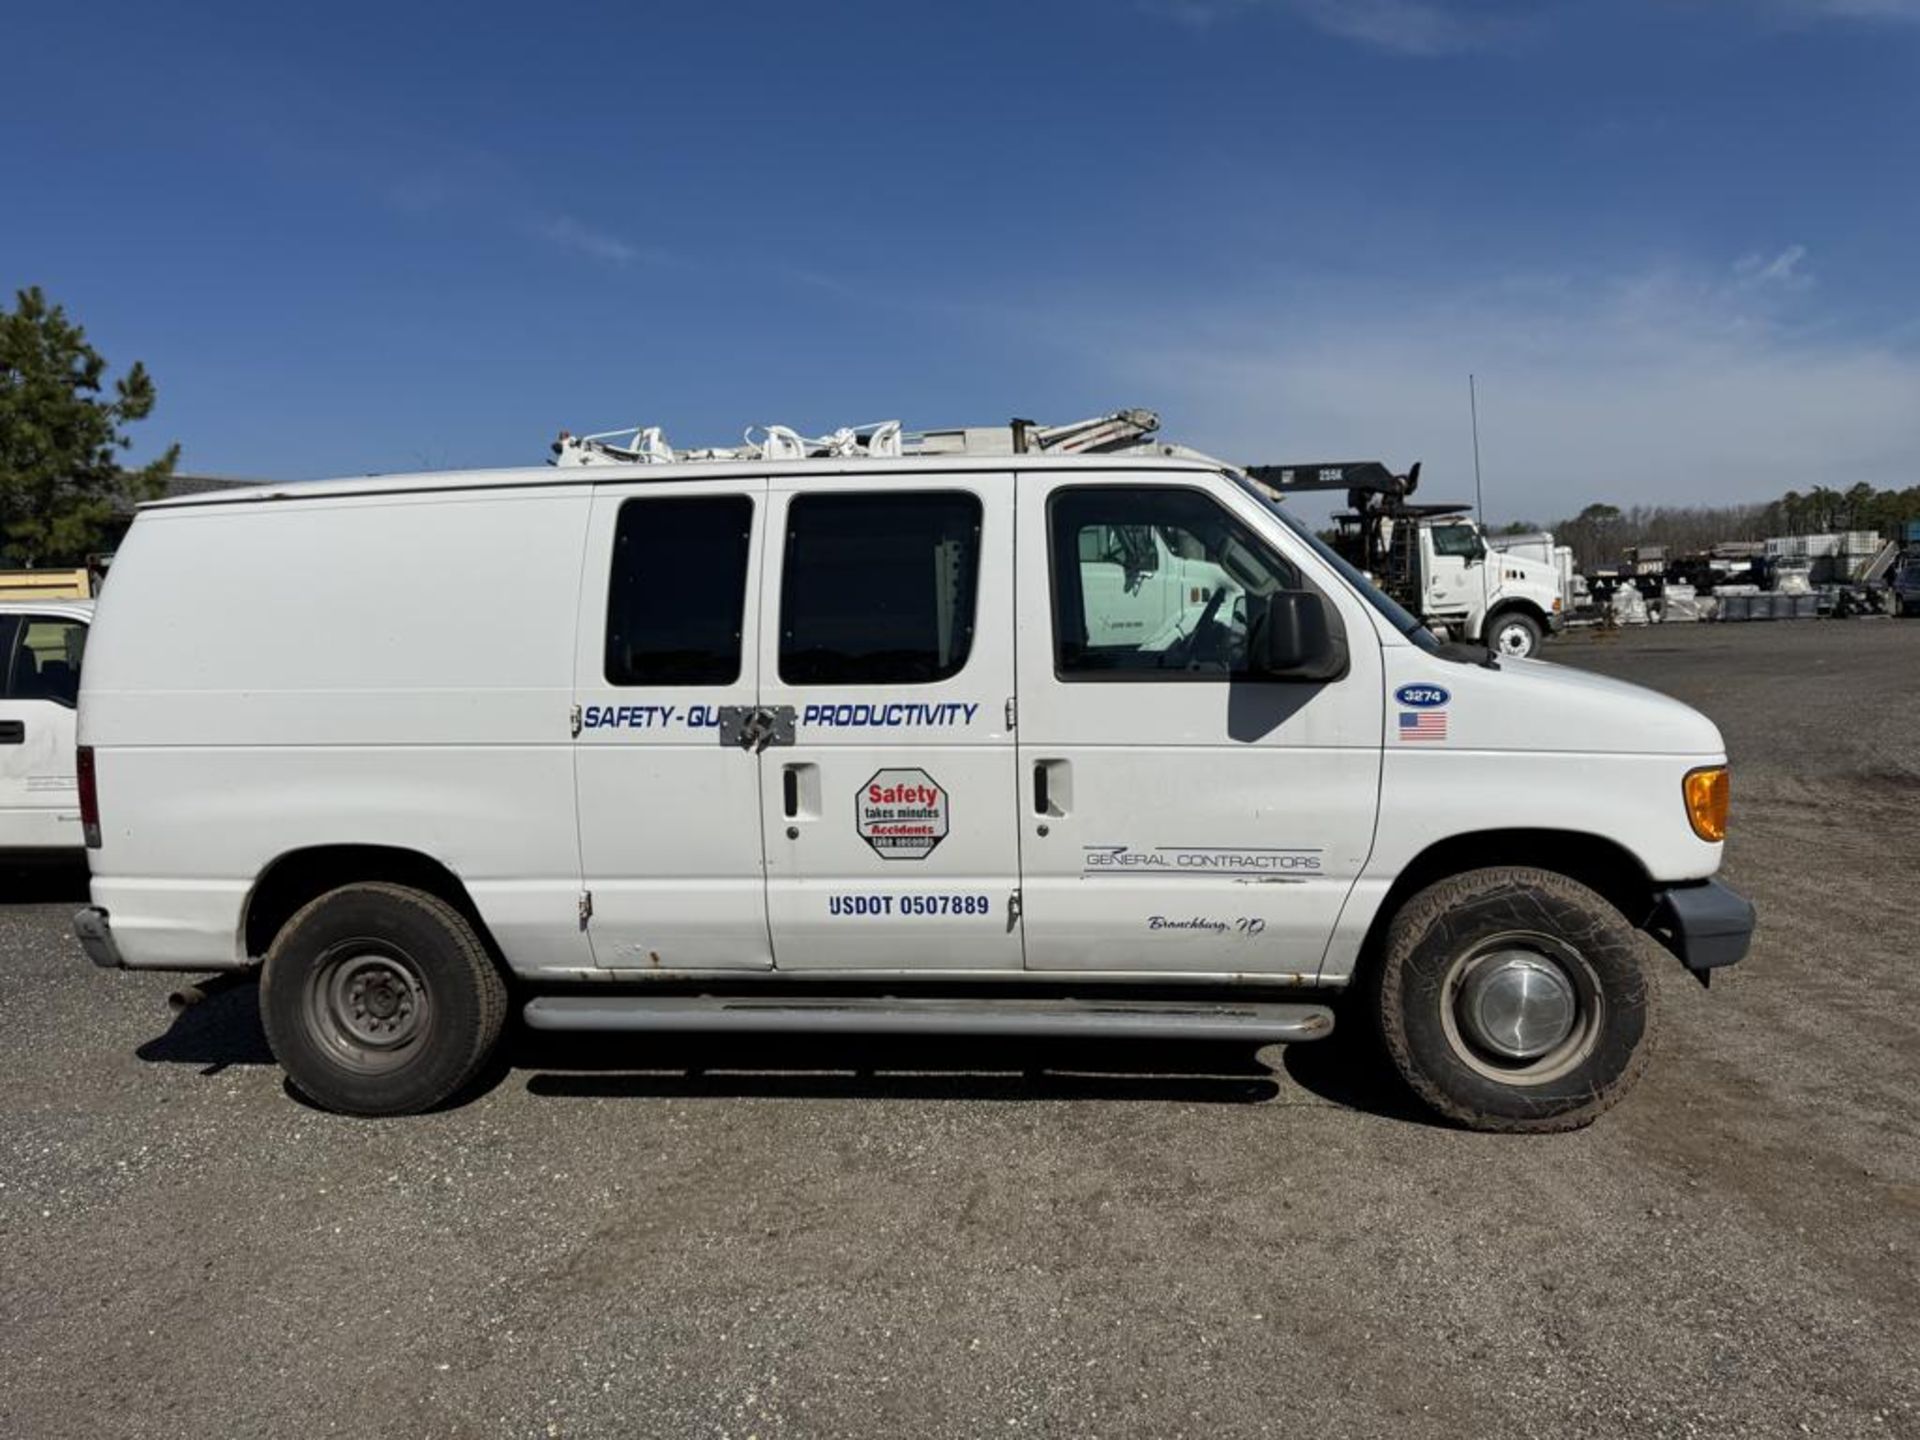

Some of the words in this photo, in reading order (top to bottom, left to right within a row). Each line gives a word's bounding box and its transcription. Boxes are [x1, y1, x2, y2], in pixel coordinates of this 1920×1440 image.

[1403, 689, 1441, 702] 3274
[584, 706, 720, 728] SAFETY-QU
[803, 703, 979, 727] PRODUCTIVITY
[869, 784, 937, 807] Safety
[865, 807, 894, 818] takes
[897, 807, 939, 818] minutes
[871, 825, 934, 835] Accidents
[1086, 854, 1169, 866] GENERAL
[1176, 854, 1321, 869] CONTRACTORS
[829, 896, 893, 915] USDOT
[900, 896, 989, 915] 0507889
